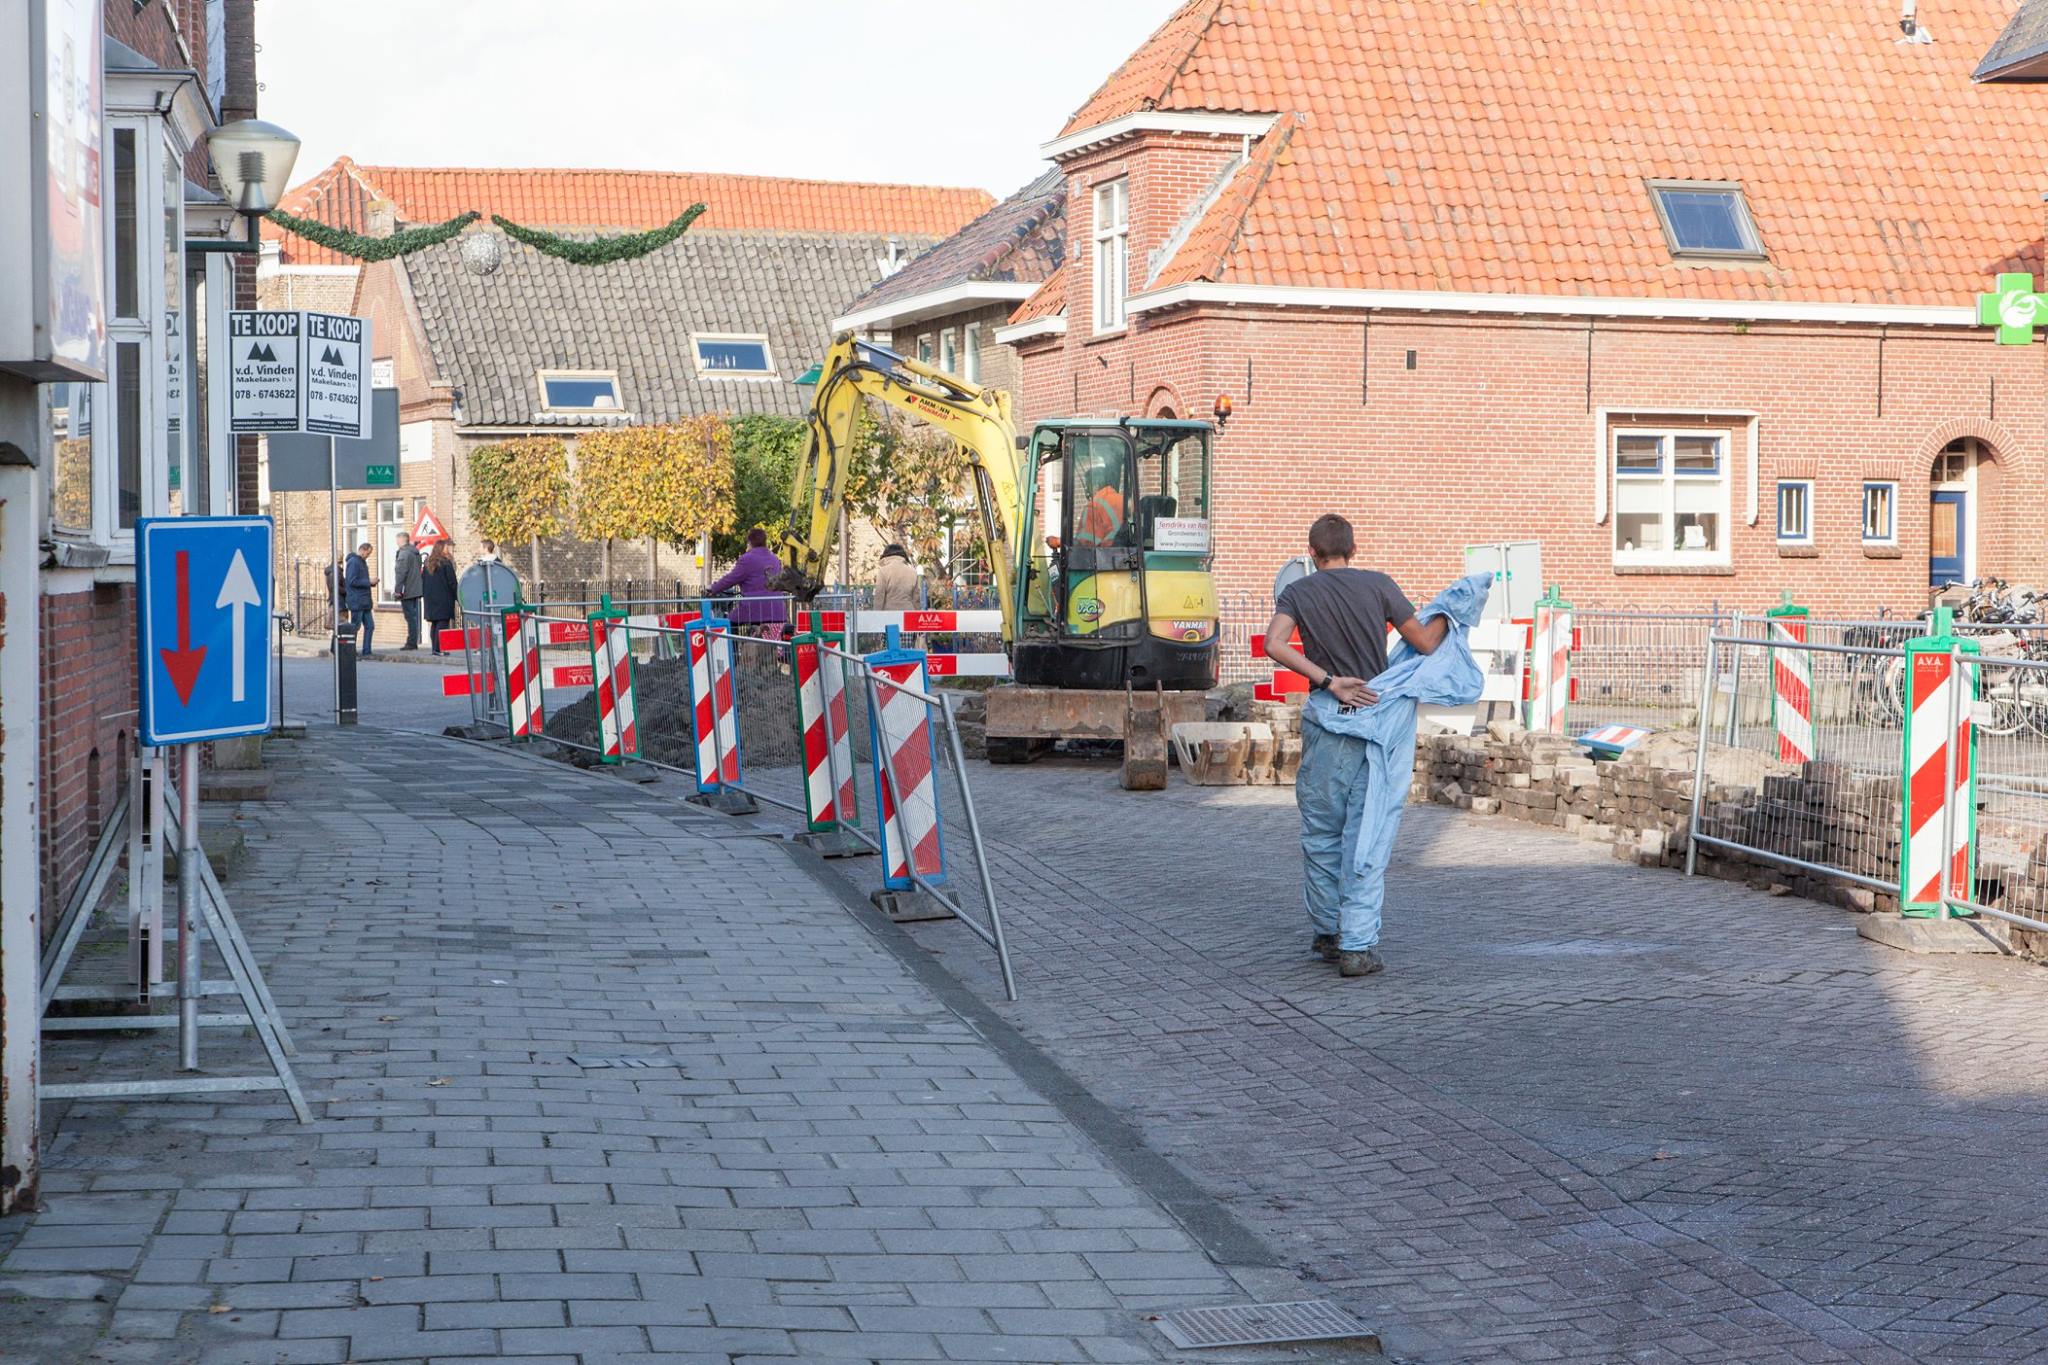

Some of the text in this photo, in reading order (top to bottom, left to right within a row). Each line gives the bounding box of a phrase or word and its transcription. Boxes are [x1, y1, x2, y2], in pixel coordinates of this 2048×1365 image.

[232, 313, 297, 335] TE KOOP
[309, 315, 360, 341] TE KOOP
[235, 364, 295, 375] v.d. Vinden
[311, 366, 358, 381] v.d. Vinden
[311, 377, 347, 387] Makelaars
[235, 390, 251, 399] 078
[258, 389, 296, 399] 6743622
[310, 390, 324, 401] 078
[328, 392, 358, 405] 6743622
[919, 398, 951, 415] AMMNN
[918, 613, 943, 623] A.V.A.
[1173, 621, 1208, 629] YANMAR
[1917, 656, 1944, 666] A.V.A.
